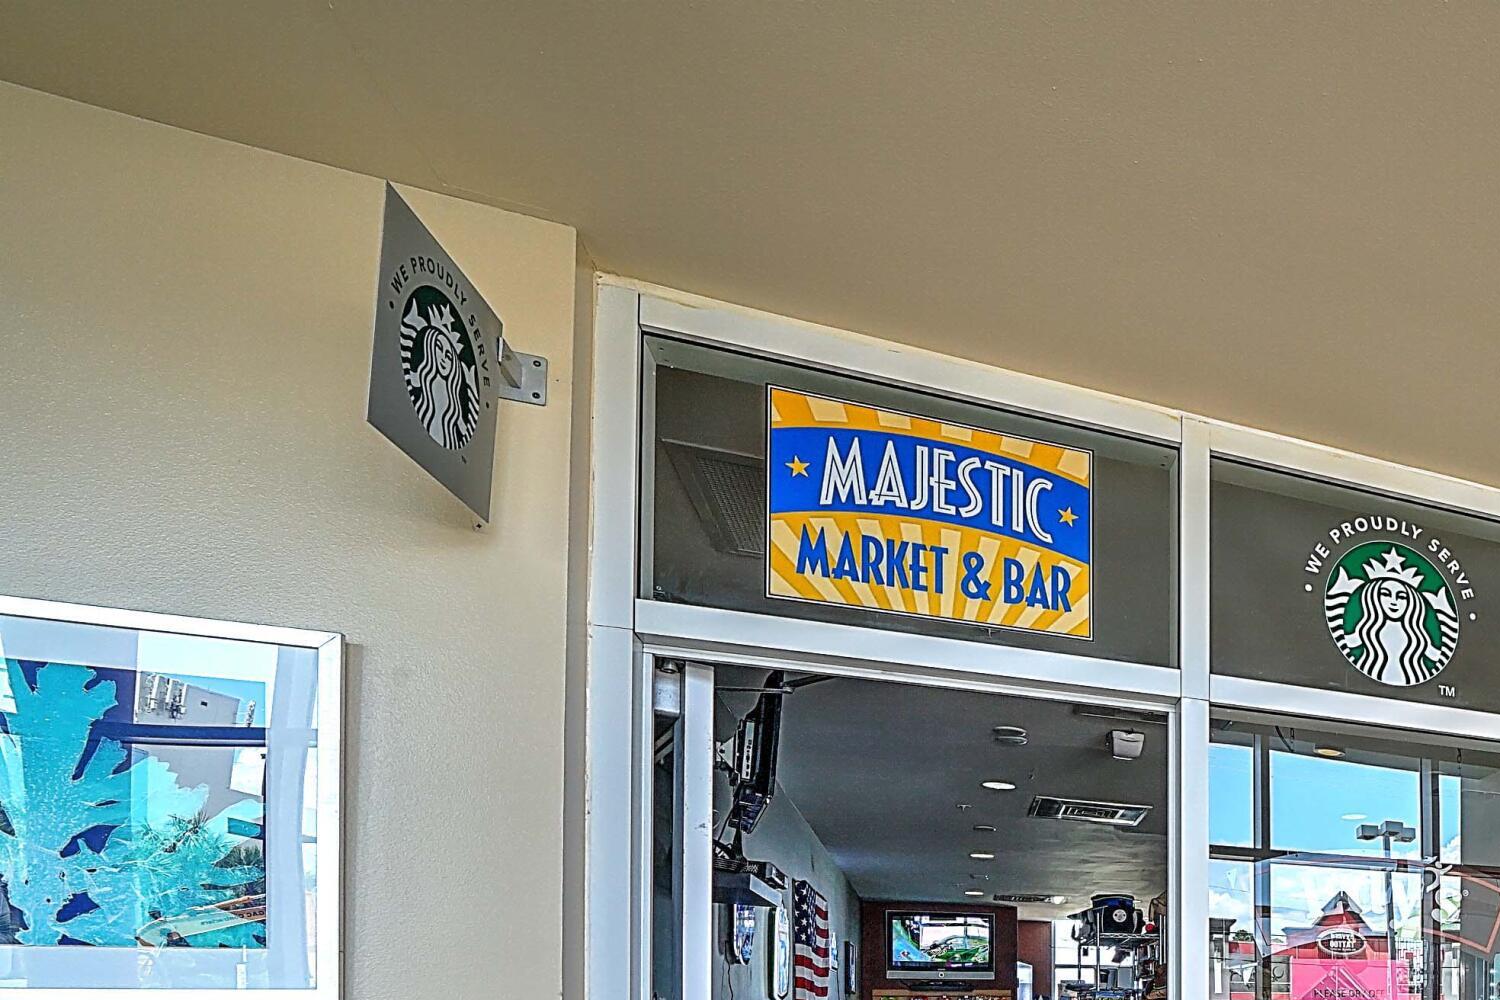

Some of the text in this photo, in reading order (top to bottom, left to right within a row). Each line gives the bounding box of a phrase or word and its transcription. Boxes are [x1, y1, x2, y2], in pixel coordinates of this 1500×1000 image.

[391, 256, 491, 388] WE PROUDLY SERVE
[819, 436, 1053, 543] MAJESTIC
[795, 524, 1072, 613] MARKET & BAR
[1305, 516, 1474, 600] WE PROUDLY SERVE
[1438, 685, 1456, 697] TM
